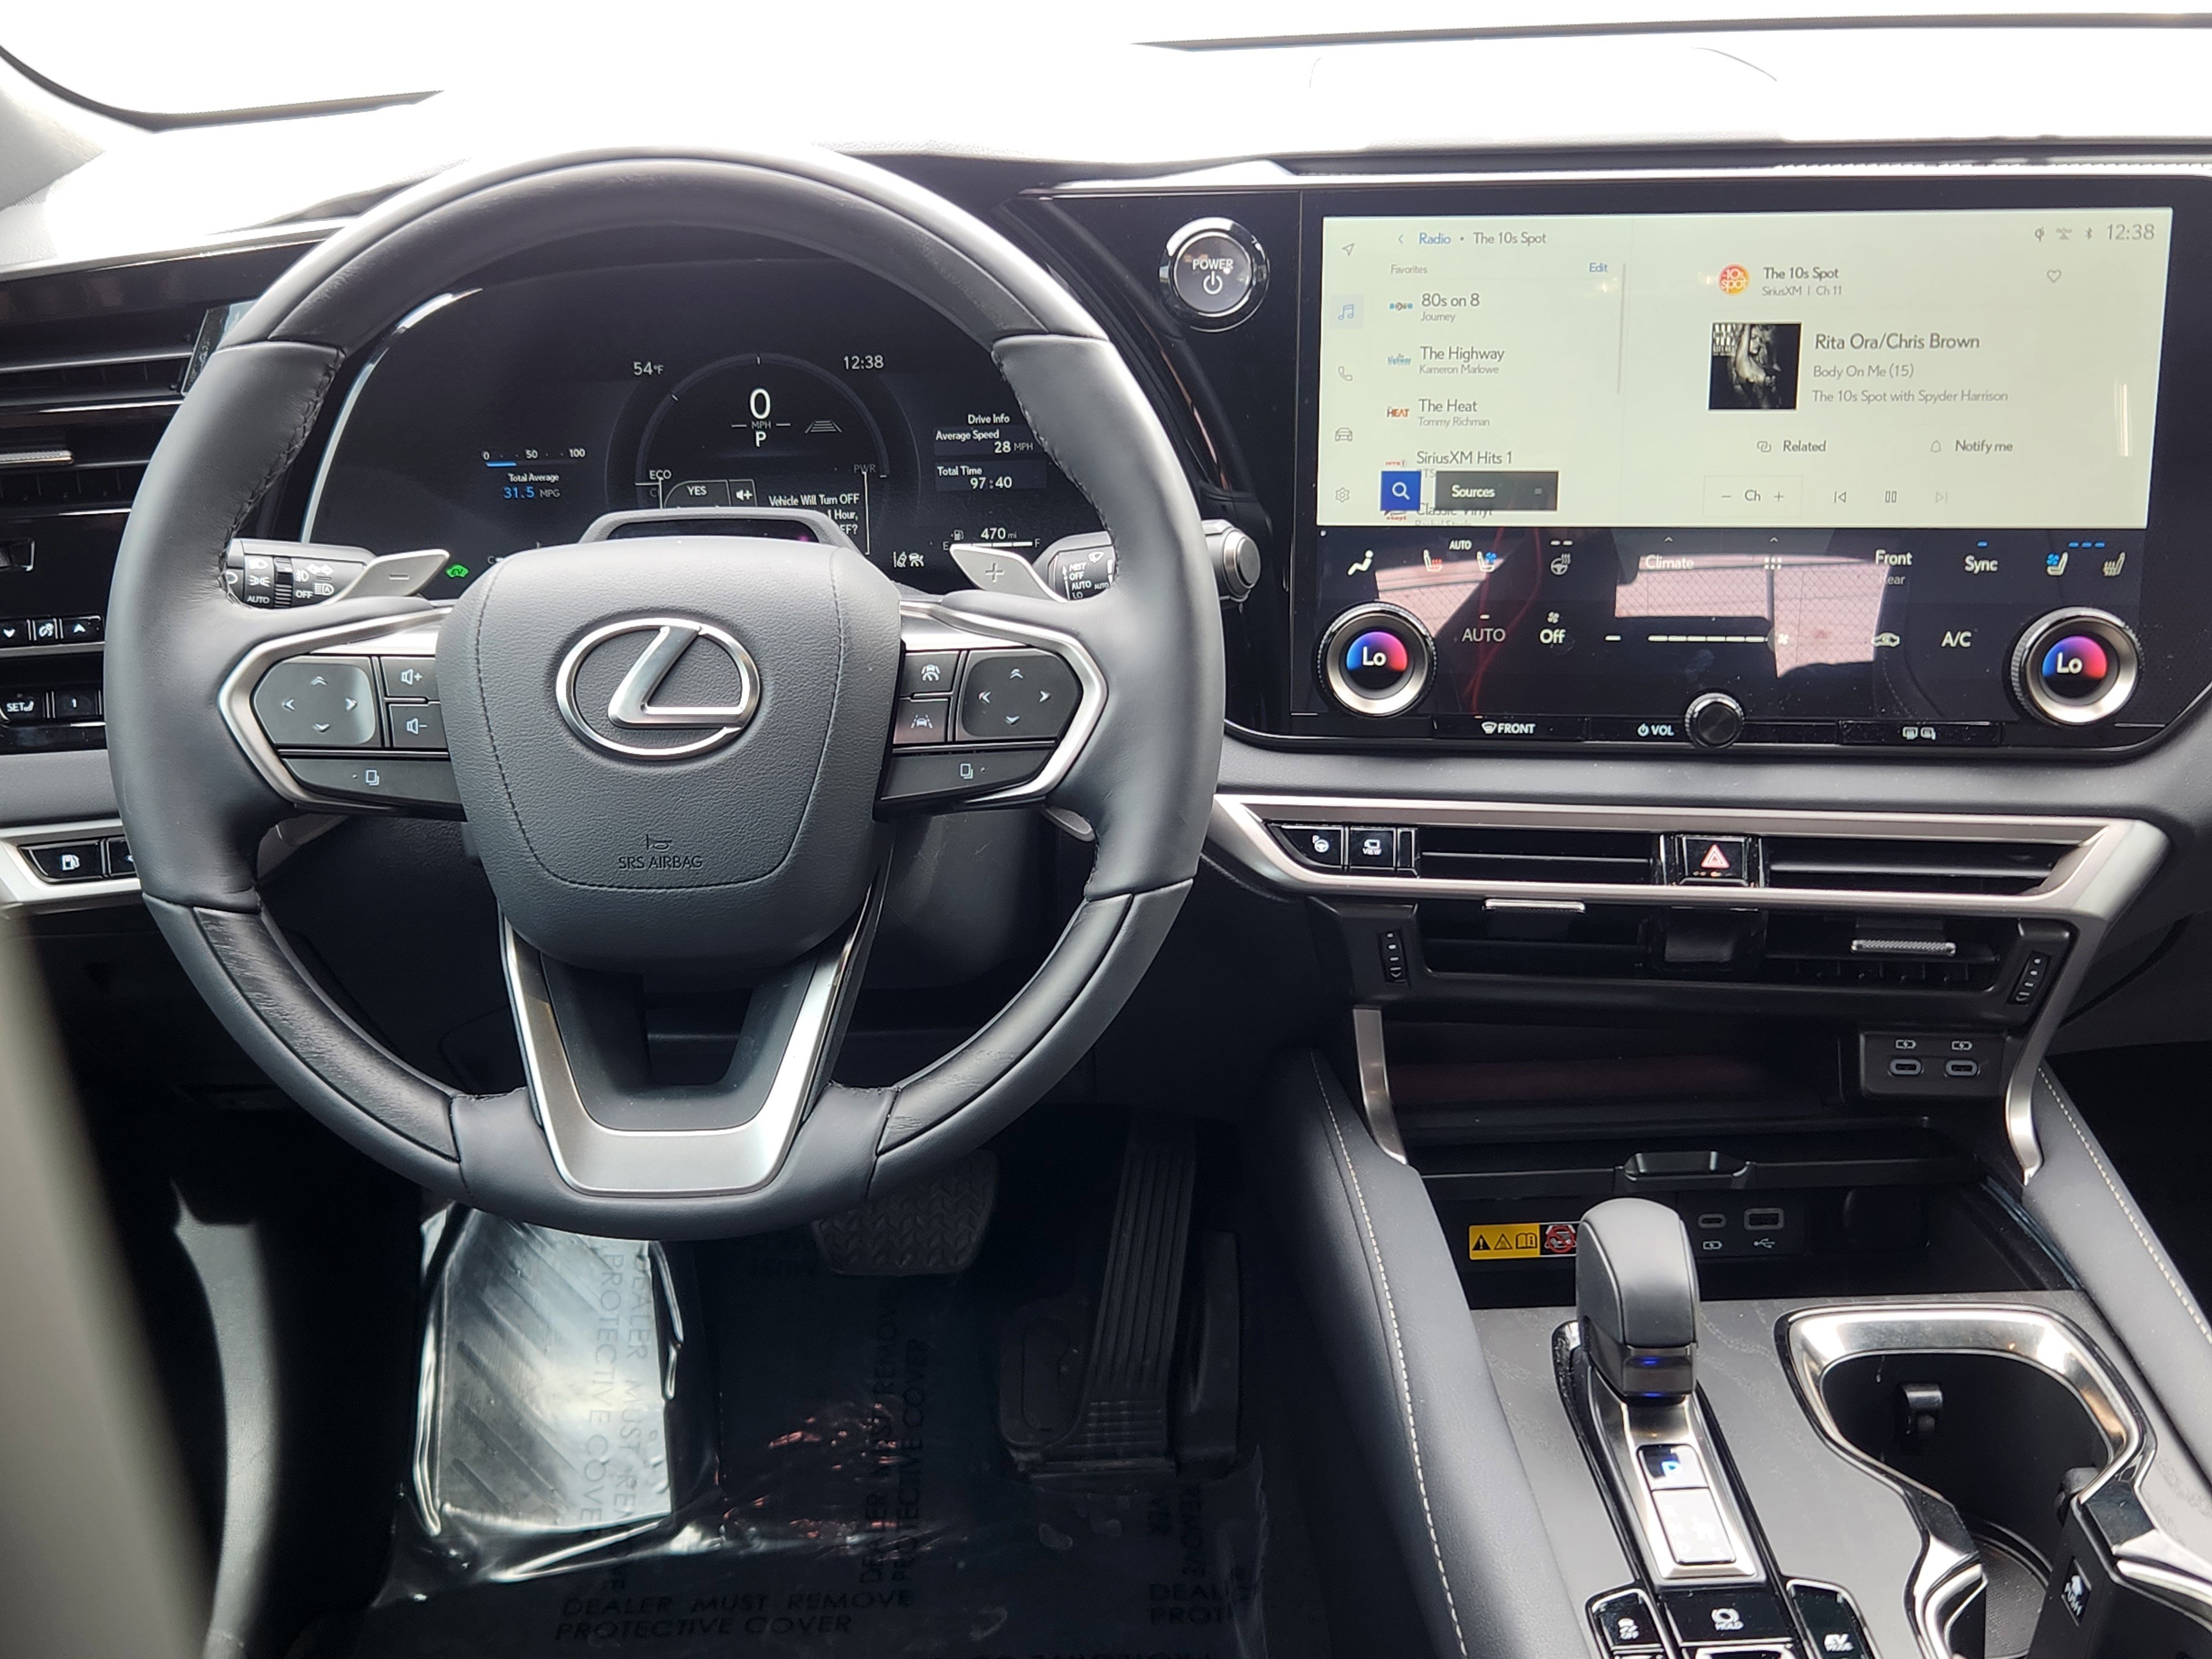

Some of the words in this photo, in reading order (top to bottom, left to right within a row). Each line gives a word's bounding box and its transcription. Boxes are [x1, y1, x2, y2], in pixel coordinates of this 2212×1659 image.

[2107, 223, 2155, 241] 12:38
[1418, 233, 1451, 245] Radio
[1473, 232, 1495, 244] The
[1498, 232, 1518, 244] 10s
[1521, 232, 1547, 247] Spot
[1192, 258, 1234, 270] POWER
[1390, 264, 1428, 274] Favorites
[1589, 263, 1608, 273] Edit
[1725, 268, 1744, 280] 10s
[1764, 268, 1786, 279] The
[1789, 268, 1809, 279] 10s
[1812, 267, 1839, 281] Spot
[1762, 286, 1802, 296] SiriusXM
[1816, 286, 1830, 296] Ch
[1833, 286, 1842, 295] 11
[1421, 294, 1448, 307] 80s
[1451, 296, 1467, 307] on
[1470, 293, 1480, 307] 8
[1420, 312, 1455, 324] Journey
[1815, 333, 1845, 349] Rita
[1850, 333, 1926, 350] Ora/Chris
[1929, 333, 1980, 349] Brown
[1420, 346, 1444, 360] The
[1448, 346, 1505, 363] Highway
[843, 356, 884, 370] 12:38
[1419, 364, 1458, 374] Kameron
[1460, 364, 1499, 374] Marlowe
[1813, 365, 1843, 379] Body
[1846, 366, 1865, 377] On
[1867, 366, 1886, 377] Me
[1889, 364, 1914, 379] (15)
[1812, 390, 1834, 402] The
[1837, 390, 1858, 402] 10s
[1860, 390, 1887, 405] Spot
[1890, 390, 1914, 402] with
[1918, 390, 1958, 404] Spyder
[1961, 390, 2008, 402] Harrison
[749, 388, 771, 420] 0
[1418, 399, 1443, 412] The
[1447, 399, 1478, 412] Heat
[968, 414, 990, 424] Drive
[993, 414, 1010, 424] Info
[1387, 408, 1410, 418] HEAT
[751, 420, 771, 430] MPH
[1418, 416, 1451, 428] Tommy
[1453, 416, 1490, 427] Richman
[755, 431, 766, 447] P
[936, 430, 971, 442] Average
[973, 429, 999, 441] Speed
[994, 442, 1011, 453] 28
[1014, 442, 1034, 451] MPH
[1783, 440, 1827, 452] Related
[1955, 439, 1992, 454] Notify
[1995, 442, 2013, 452] me
[483, 451, 490, 461] 0
[525, 449, 538, 460] 50
[569, 448, 586, 458] 100
[1416, 451, 1473, 465] SiriusXM
[1477, 451, 1504, 464] Hits
[1506, 451, 1512, 464] 1
[649, 469, 672, 480] ECO
[853, 464, 876, 474] PWR
[937, 466, 959, 477] Total
[961, 466, 982, 476] Time
[508, 473, 528, 483] Total
[528, 473, 559, 484] Average
[970, 477, 1013, 489] 97:40
[503, 486, 535, 499] 31.5
[539, 489, 560, 498] MPG
[686, 486, 707, 495] YES
[1452, 484, 1495, 498] Sources
[1744, 489, 1761, 502] Ch
[769, 495, 799, 507] Vehicle
[800, 494, 817, 506] Will
[818, 494, 837, 505] Turn
[839, 493, 860, 505] OFF
[834, 509, 859, 521] Hour,
[839, 524, 858, 535] FF?
[980, 528, 1006, 540] 470
[943, 541, 949, 550] E
[1035, 538, 1041, 547] F
[1449, 540, 1472, 550] AUTO
[1645, 554, 1694, 570] Climate
[1875, 549, 1913, 566] Front
[1964, 555, 1999, 573] Sync
[1069, 571, 1084, 581] OFF
[1882, 575, 1906, 586] ear
[1071, 581, 1092, 591] AUTO
[1094, 582, 1109, 591] AUTO
[247, 595, 270, 604] AUTO
[295, 589, 314, 599] OFF
[1072, 591, 1083, 599] LO
[1462, 628, 1506, 643] AUTO
[1540, 628, 1566, 644] Off
[1942, 630, 1972, 648] A/C
[1363, 646, 1386, 666] Lo
[2057, 653, 2083, 674] Lo
[6, 702, 25, 712] SET
[71, 698, 77, 708] 1
[1498, 722, 1536, 734] FRONT
[1651, 725, 1674, 737] VOL
[618, 856, 645, 869] SRS
[648, 855, 703, 869] AIRBAG
[588, 1253, 625, 1424] PROTECTIVE
[618, 1379, 647, 1454] MUST
[691, 1592, 771, 1613] MUST
[744, 1614, 852, 1636] COVER
